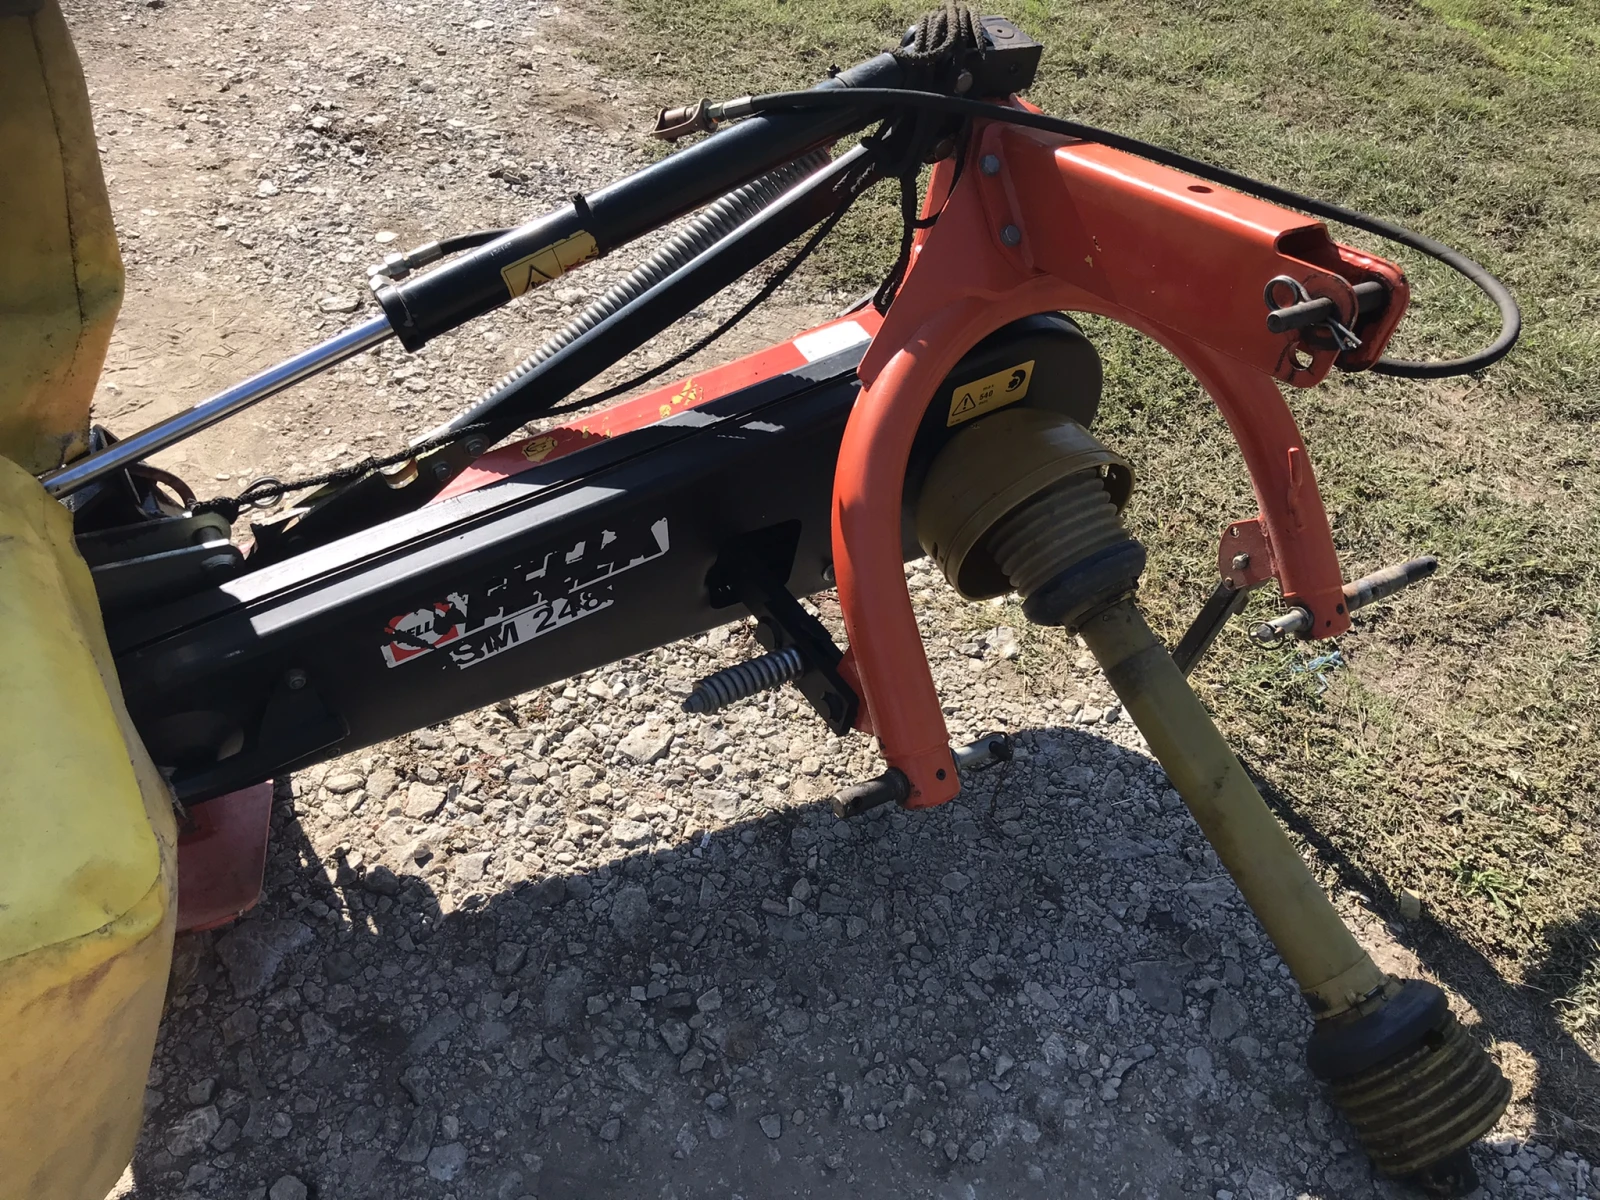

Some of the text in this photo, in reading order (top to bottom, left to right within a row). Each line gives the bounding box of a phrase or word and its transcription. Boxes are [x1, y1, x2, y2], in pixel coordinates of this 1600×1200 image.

[979, 390, 994, 401] 540
[452, 592, 601, 666] SM 248
